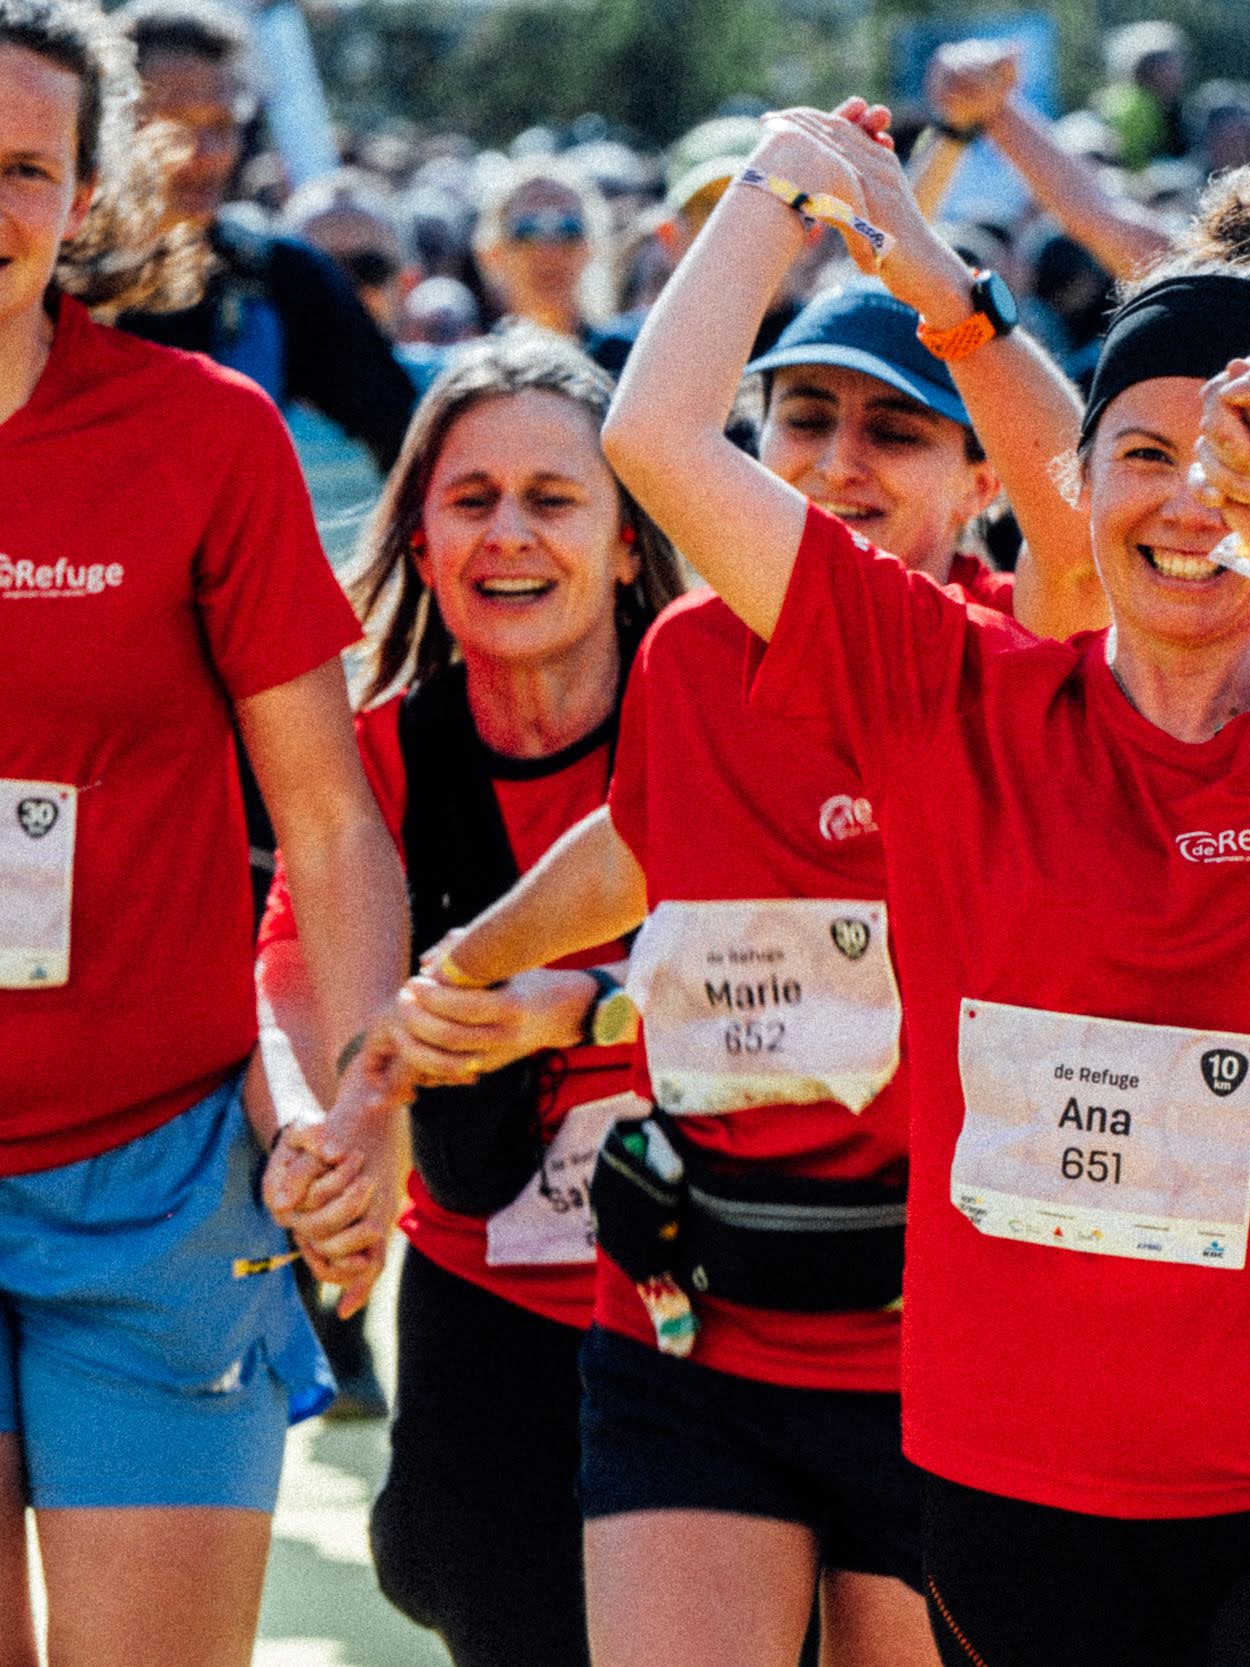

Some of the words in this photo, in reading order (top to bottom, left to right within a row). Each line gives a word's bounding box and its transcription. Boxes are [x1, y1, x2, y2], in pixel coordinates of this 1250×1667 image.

[15, 556, 124, 594] Refuge
[725, 1020, 786, 1055] 652
[1054, 1063, 1074, 1080] de
[1079, 1067, 1140, 1090] Refuge
[1208, 1054, 1240, 1081] 10
[1213, 1080, 1232, 1091] km
[1058, 1096, 1132, 1137] Ana
[1061, 1146, 1122, 1185] 651
